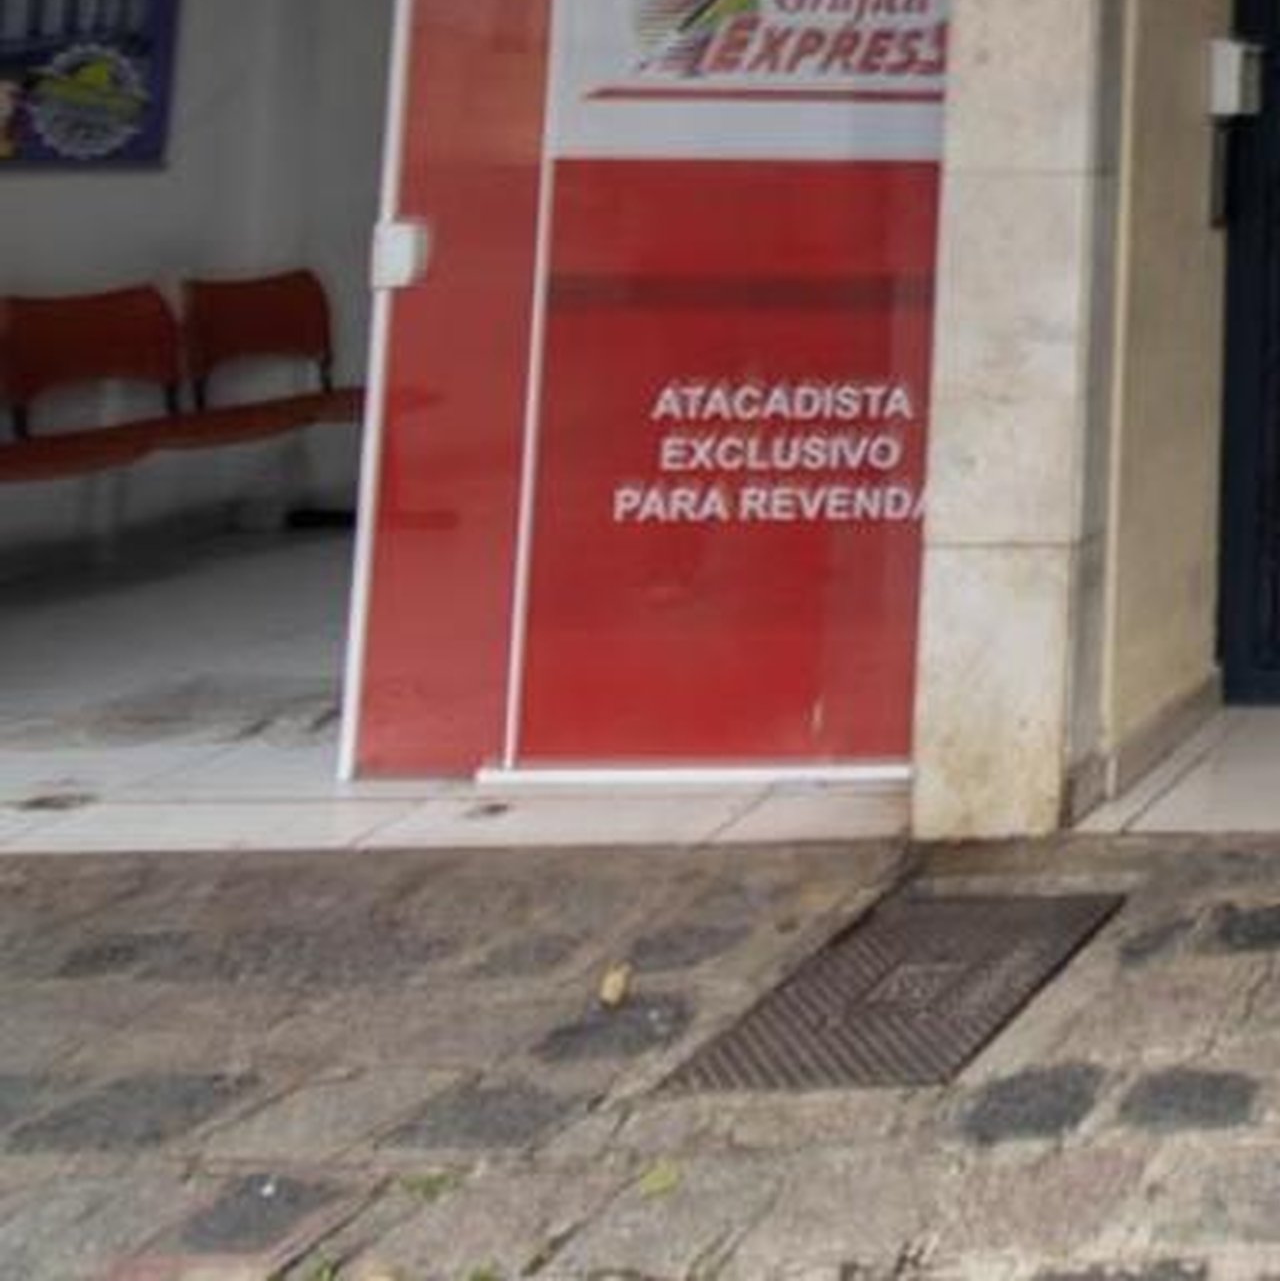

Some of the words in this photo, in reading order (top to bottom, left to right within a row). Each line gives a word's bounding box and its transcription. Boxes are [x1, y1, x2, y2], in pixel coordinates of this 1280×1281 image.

[651, 386, 913, 420] ATACADISTA
[659, 436, 900, 470] EXCLUSIVO
[613, 488, 728, 520] PARA
